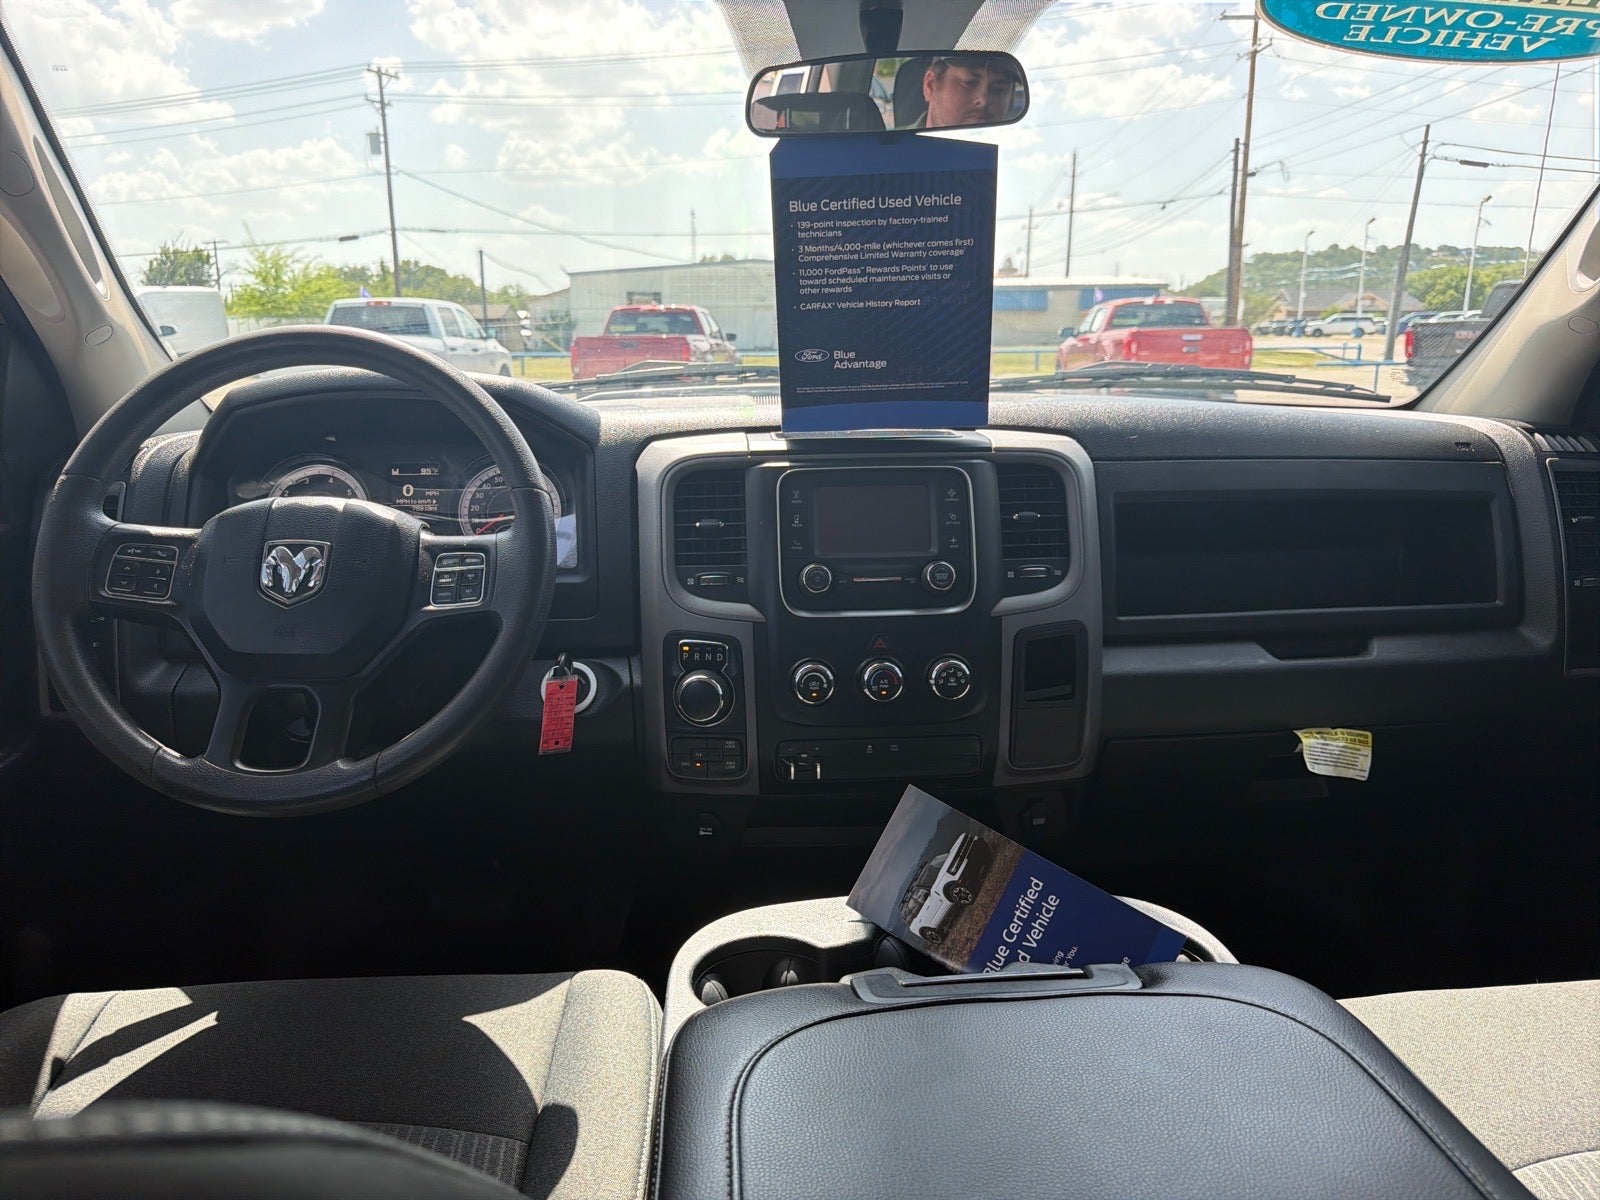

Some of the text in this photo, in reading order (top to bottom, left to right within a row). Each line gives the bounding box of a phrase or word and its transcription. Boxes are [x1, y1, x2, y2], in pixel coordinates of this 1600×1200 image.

[789, 193, 962, 212] Blue Certified Used Vehicle
[797, 214, 949, 230] 139-point inspection by factory-trained
[797, 230, 842, 239] technicians
[798, 245, 803, 253] 3
[882, 241, 925, 250] (whichever
[955, 238, 974, 246] first)
[798, 252, 859, 263] Comprehensive
[860, 250, 889, 259] Limited
[890, 249, 927, 258] Warranty
[799, 268, 823, 277] 11,000
[866, 265, 900, 274] Rewards
[929, 263, 938, 271] to
[799, 277, 827, 286] toward
[828, 275, 868, 285] scheduled
[869, 273, 920, 283] maintenance
[920, 272, 942, 281] visits
[799, 285, 853, 295] other rewards
[836, 301, 865, 309] Vehicle
[865, 299, 894, 308] History
[894, 298, 921, 307] Report
[833, 350, 856, 359] Blue
[833, 360, 888, 369] Advantage
[304, 477, 310, 485] 3
[328, 476, 334, 484] 4
[346, 488, 352, 496] 5
[402, 483, 414, 497] 0
[683, 652, 724, 661] P R N D
[1002, 876, 1044, 943] Certified
[1022, 894, 1060, 948] Vehicle
[1065, 946, 1079, 960] You.
